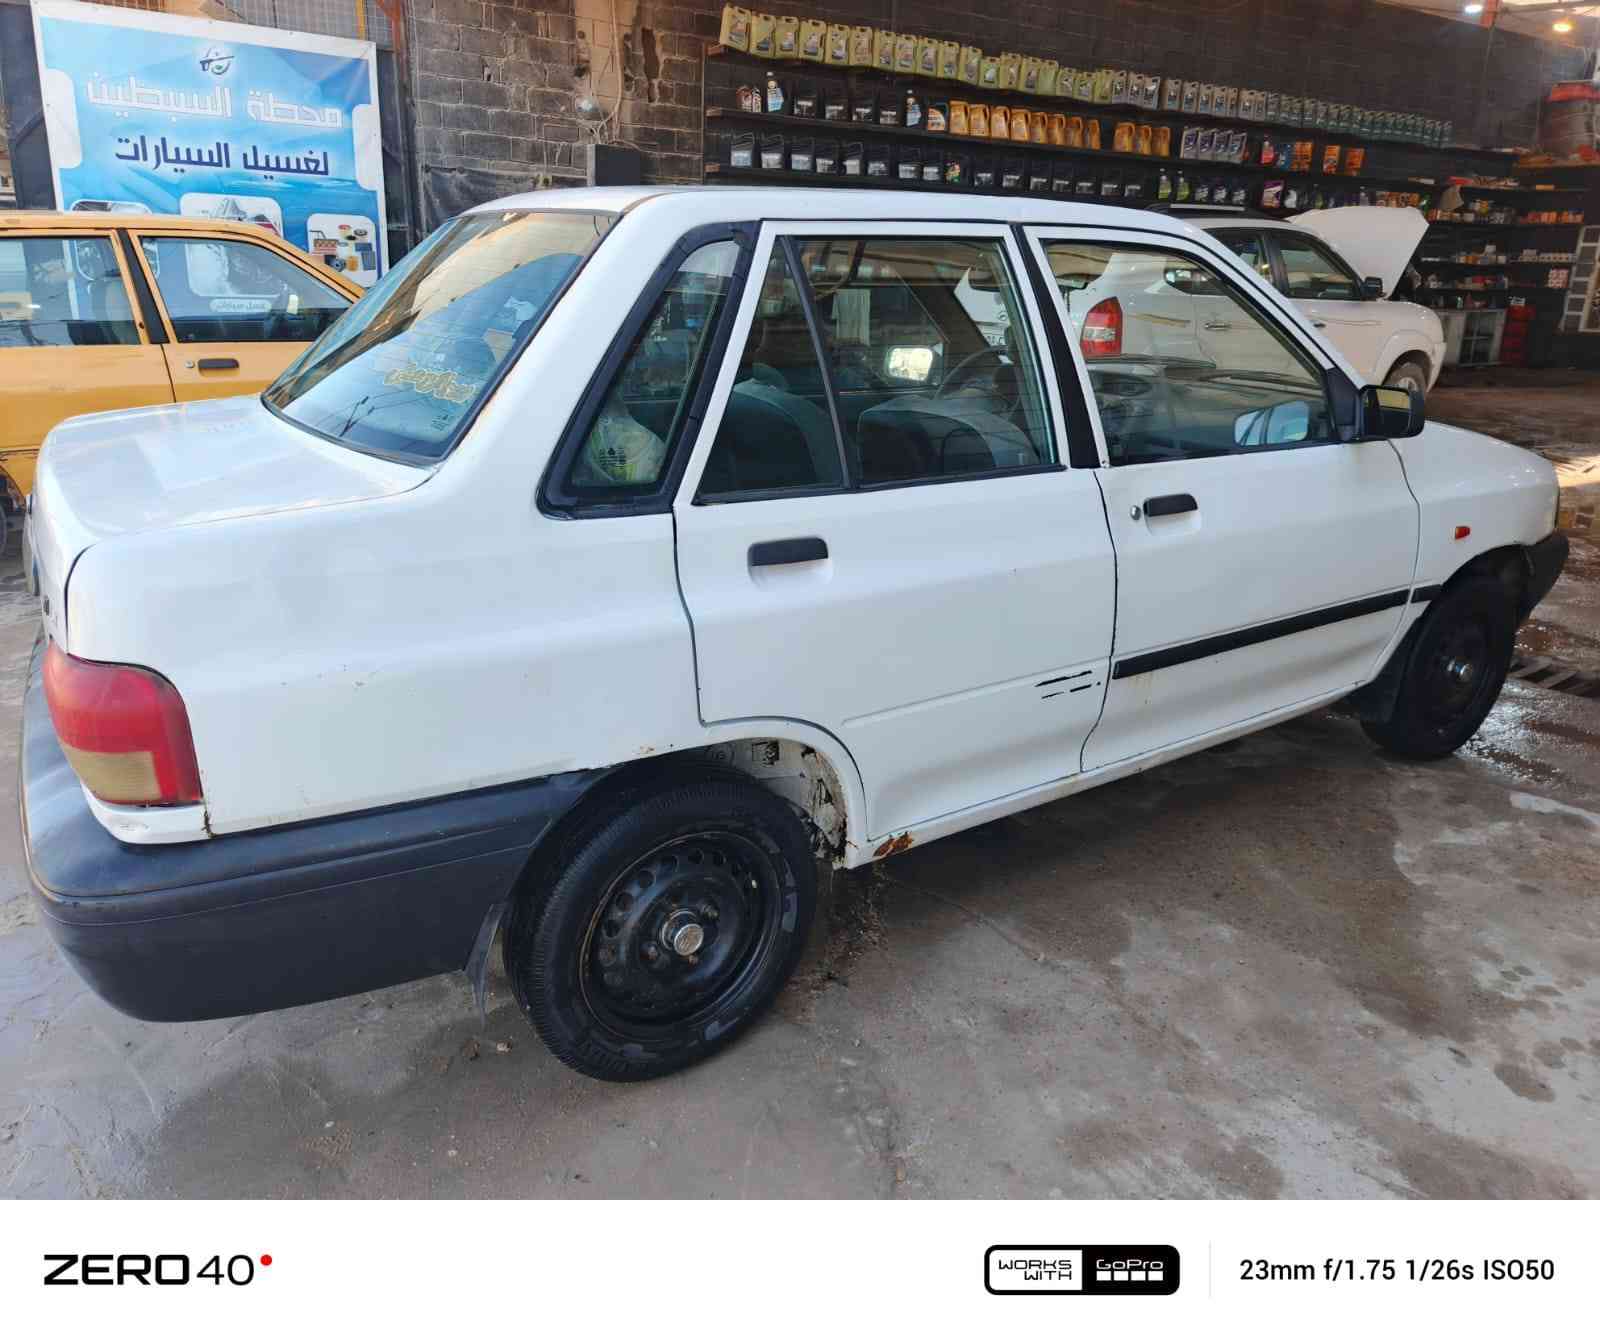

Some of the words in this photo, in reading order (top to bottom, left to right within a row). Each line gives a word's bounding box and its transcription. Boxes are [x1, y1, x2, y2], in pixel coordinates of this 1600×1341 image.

[86, 71, 233, 123] السبطين
[246, 90, 344, 129] محطة
[115, 135, 231, 174] السيارات
[242, 145, 330, 180] لغسيل
